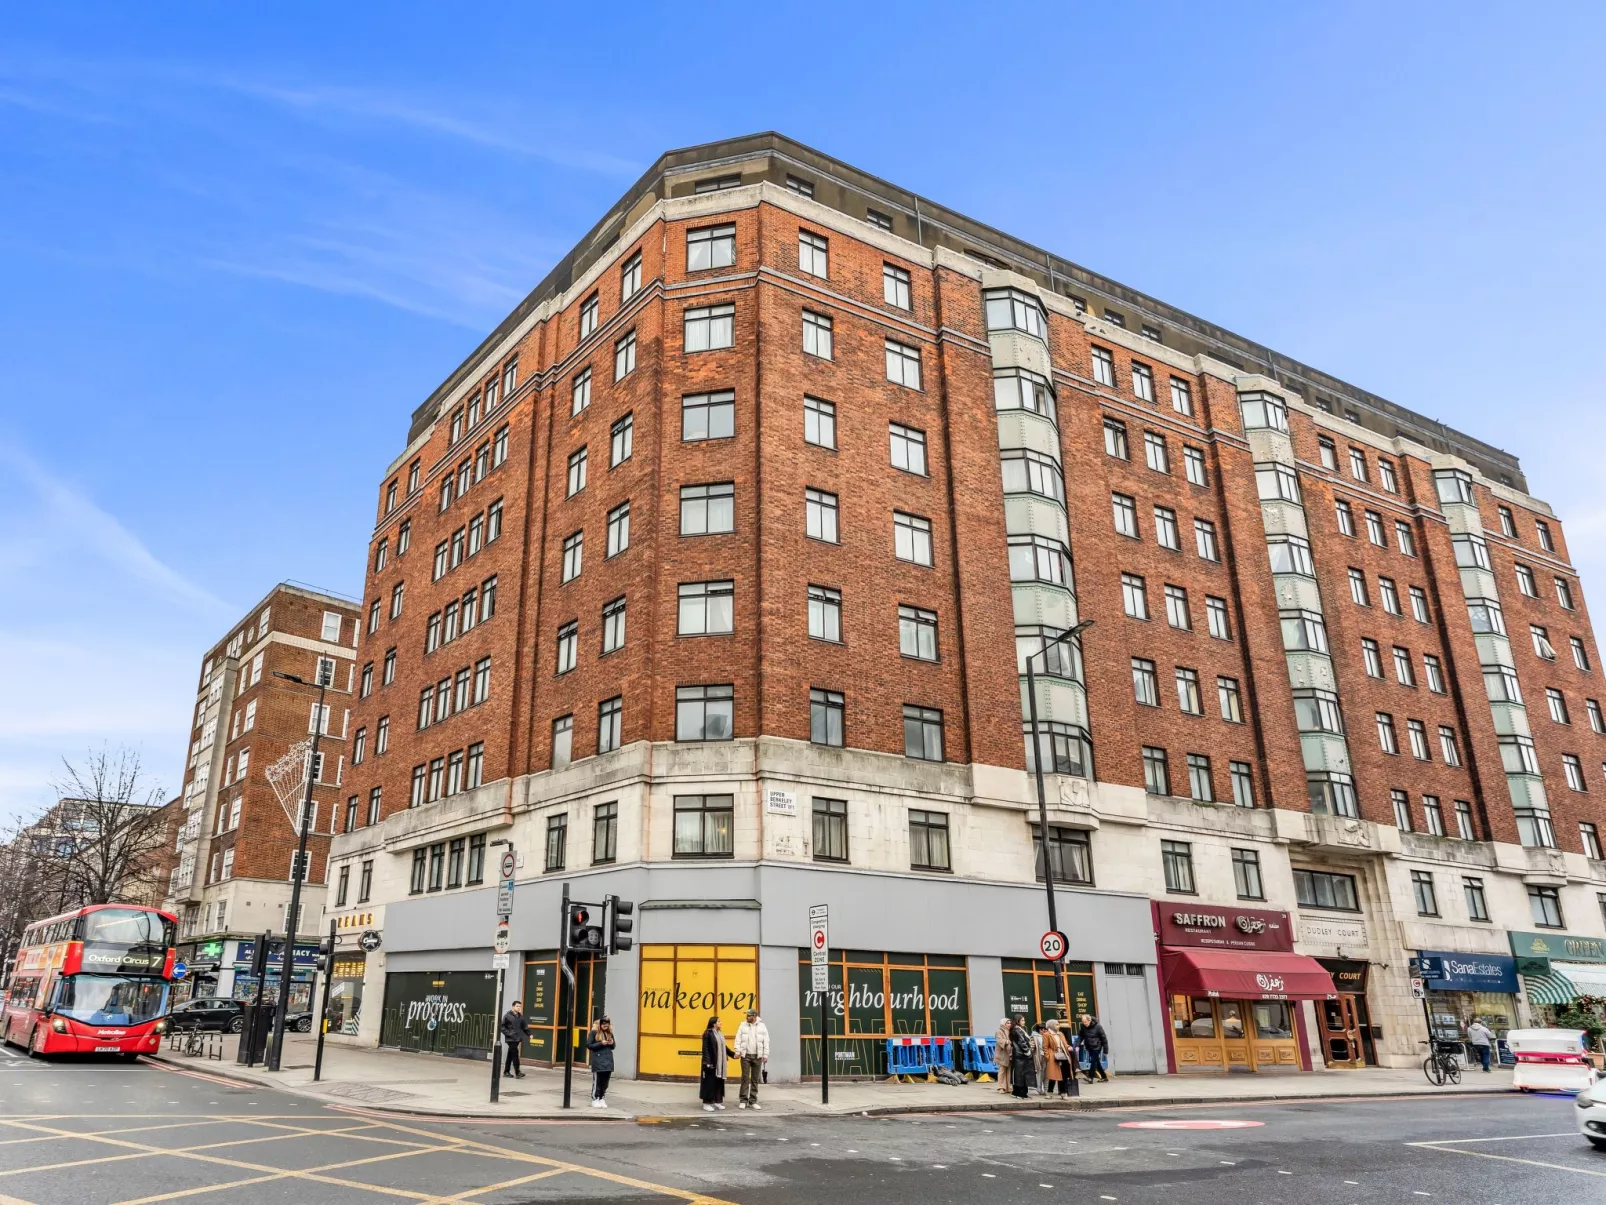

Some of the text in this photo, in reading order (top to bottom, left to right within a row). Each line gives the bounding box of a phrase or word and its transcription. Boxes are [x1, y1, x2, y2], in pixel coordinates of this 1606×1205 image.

[1175, 913, 1226, 928] SAFFRON
[1306, 926, 1332, 936] DUDLEY
[1044, 940, 1060, 952] 20
[1565, 940, 1604, 958] GREEN
[88, 954, 162, 967] Oxford Circus 7
[1451, 960, 1502, 976] SanaEstates
[426, 994, 448, 1003] WORK IN
[640, 982, 757, 1010] makeover
[405, 1000, 466, 1030] progress
